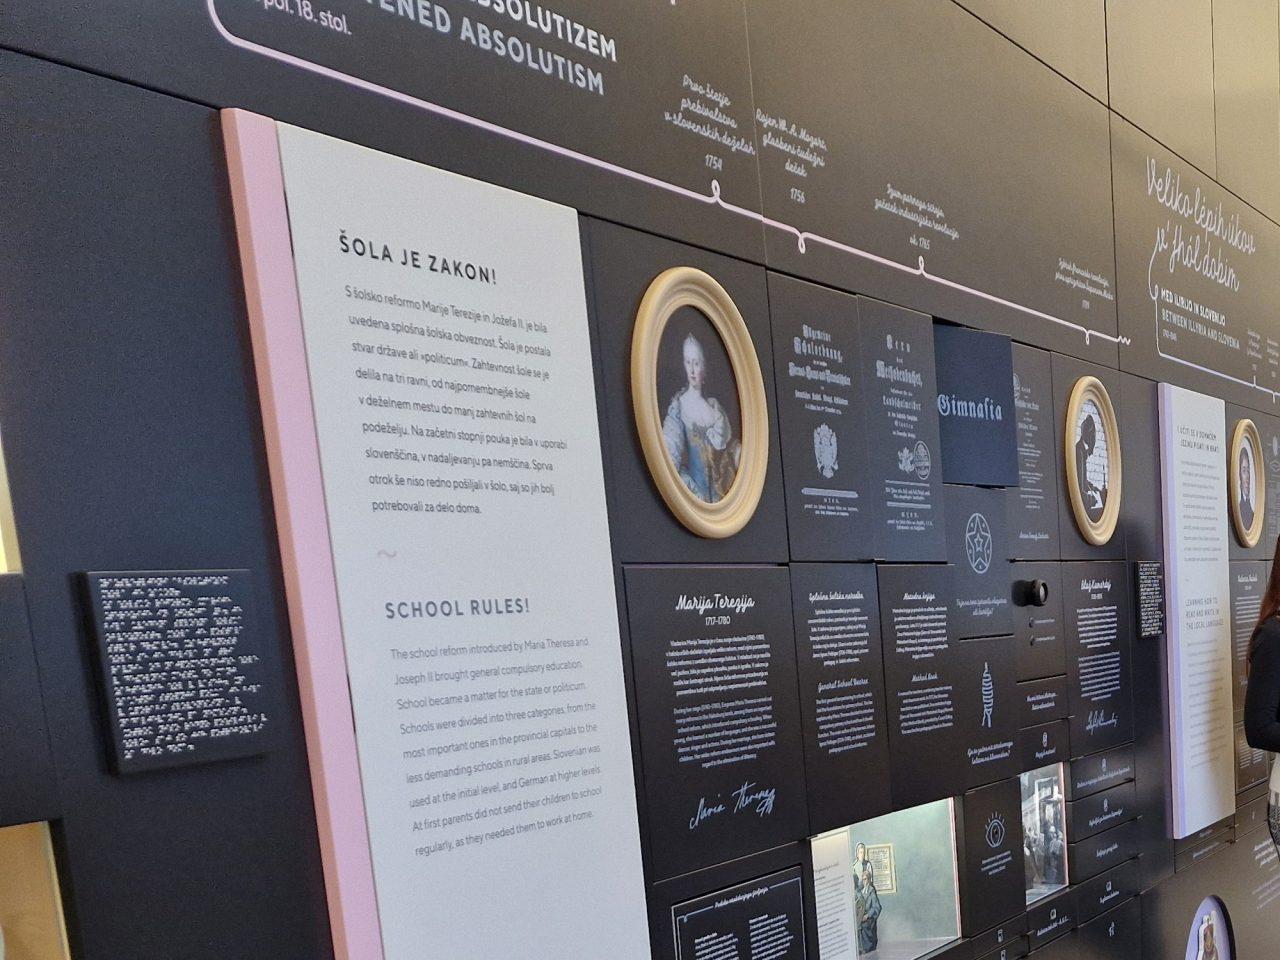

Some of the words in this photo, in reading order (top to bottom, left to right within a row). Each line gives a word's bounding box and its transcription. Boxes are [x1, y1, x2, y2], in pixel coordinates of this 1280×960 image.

[319, 10, 352, 35] stol.
[460, 16, 604, 96] ABSOLUTISM
[339, 231, 393, 262] ŠOLA
[401, 249, 421, 268] JE
[428, 255, 497, 284] ZAKON!
[353, 286, 383, 303] šolsko
[384, 294, 421, 310] reformo
[422, 300, 449, 317] Marije
[450, 305, 481, 323] Terezije
[492, 313, 517, 328] Jožefa
[534, 321, 547, 334] bila
[348, 316, 390, 331] uvedena
[391, 321, 425, 336] splošna
[426, 326, 452, 341] šolska
[498, 335, 515, 351] Šola
[524, 344, 551, 356] postala
[352, 342, 375, 354] stvar
[376, 343, 408, 358] države
[471, 357, 516, 374] Zahtevnost
[516, 363, 532, 377] šole
[355, 367, 381, 381] delila
[407, 375, 430, 389] ravni,
[444, 379, 514, 399] najpomembnejše
[515, 387, 530, 400] šole
[365, 394, 411, 410] deželnem
[412, 402, 440, 413] mestu
[454, 405, 474, 420] manj
[476, 407, 513, 421] zahtevnih
[362, 421, 409, 438] podeželju.
[425, 427, 456, 440] začetni
[457, 430, 483, 444] stopnji
[485, 432, 510, 445] pouka
[519, 434, 533, 446] bila
[539, 437, 568, 450] uporabi
[365, 447, 420, 463] slovenščina,
[428, 451, 480, 468] nadaljevanju
[369, 474, 394, 485] otrok
[407, 475, 425, 487] niso
[426, 476, 452, 488] redno
[453, 477, 483, 492] pošiljali
[490, 479, 508, 493] šolo,
[372, 500, 423, 513] potrebovali
[436, 501, 455, 512] delo
[456, 501, 482, 513] doma.
[385, 599, 464, 619] SCHOOL
[471, 596, 529, 615] RULES!
[675, 594, 714, 615] Marija
[713, 593, 756, 613] Terezija
[439, 644, 467, 656] reform
[469, 640, 512, 654] introduced
[546, 637, 575, 649] Theresa
[395, 671, 426, 685] Joseph
[435, 667, 469, 682] brought
[470, 664, 500, 681] general
[501, 662, 545, 677] compulsory
[397, 695, 427, 709] School
[429, 694, 463, 706] became
[471, 690, 498, 702] matter
[525, 685, 543, 696] state
[400, 719, 435, 734] Schools
[436, 719, 456, 729] were
[458, 712, 488, 727] divided
[489, 711, 504, 723] into
[506, 709, 526, 721] three
[566, 702, 584, 713] from
[403, 746, 426, 758] most
[427, 740, 468, 756] important
[470, 738, 489, 749] ones
[513, 727, 549, 745] provincial
[550, 723, 576, 739] capitals
[406, 771, 423, 783] less
[424, 763, 472, 780] demanding
[473, 757, 504, 772] schools
[512, 753, 530, 766] rural
[553, 745, 587, 760] Slovenian
[409, 793, 431, 807] used
[457, 784, 479, 799] initial
[518, 775, 549, 788] German
[558, 767, 580, 782] higher
[424, 816, 442, 829] first
[442, 811, 473, 828] parents
[503, 799, 522, 813] send
[523, 796, 540, 809] their
[541, 791, 571, 806] children
[466, 832, 484, 845] they
[485, 823, 515, 841] needed
[516, 821, 536, 834] them
[546, 813, 563, 827] work
